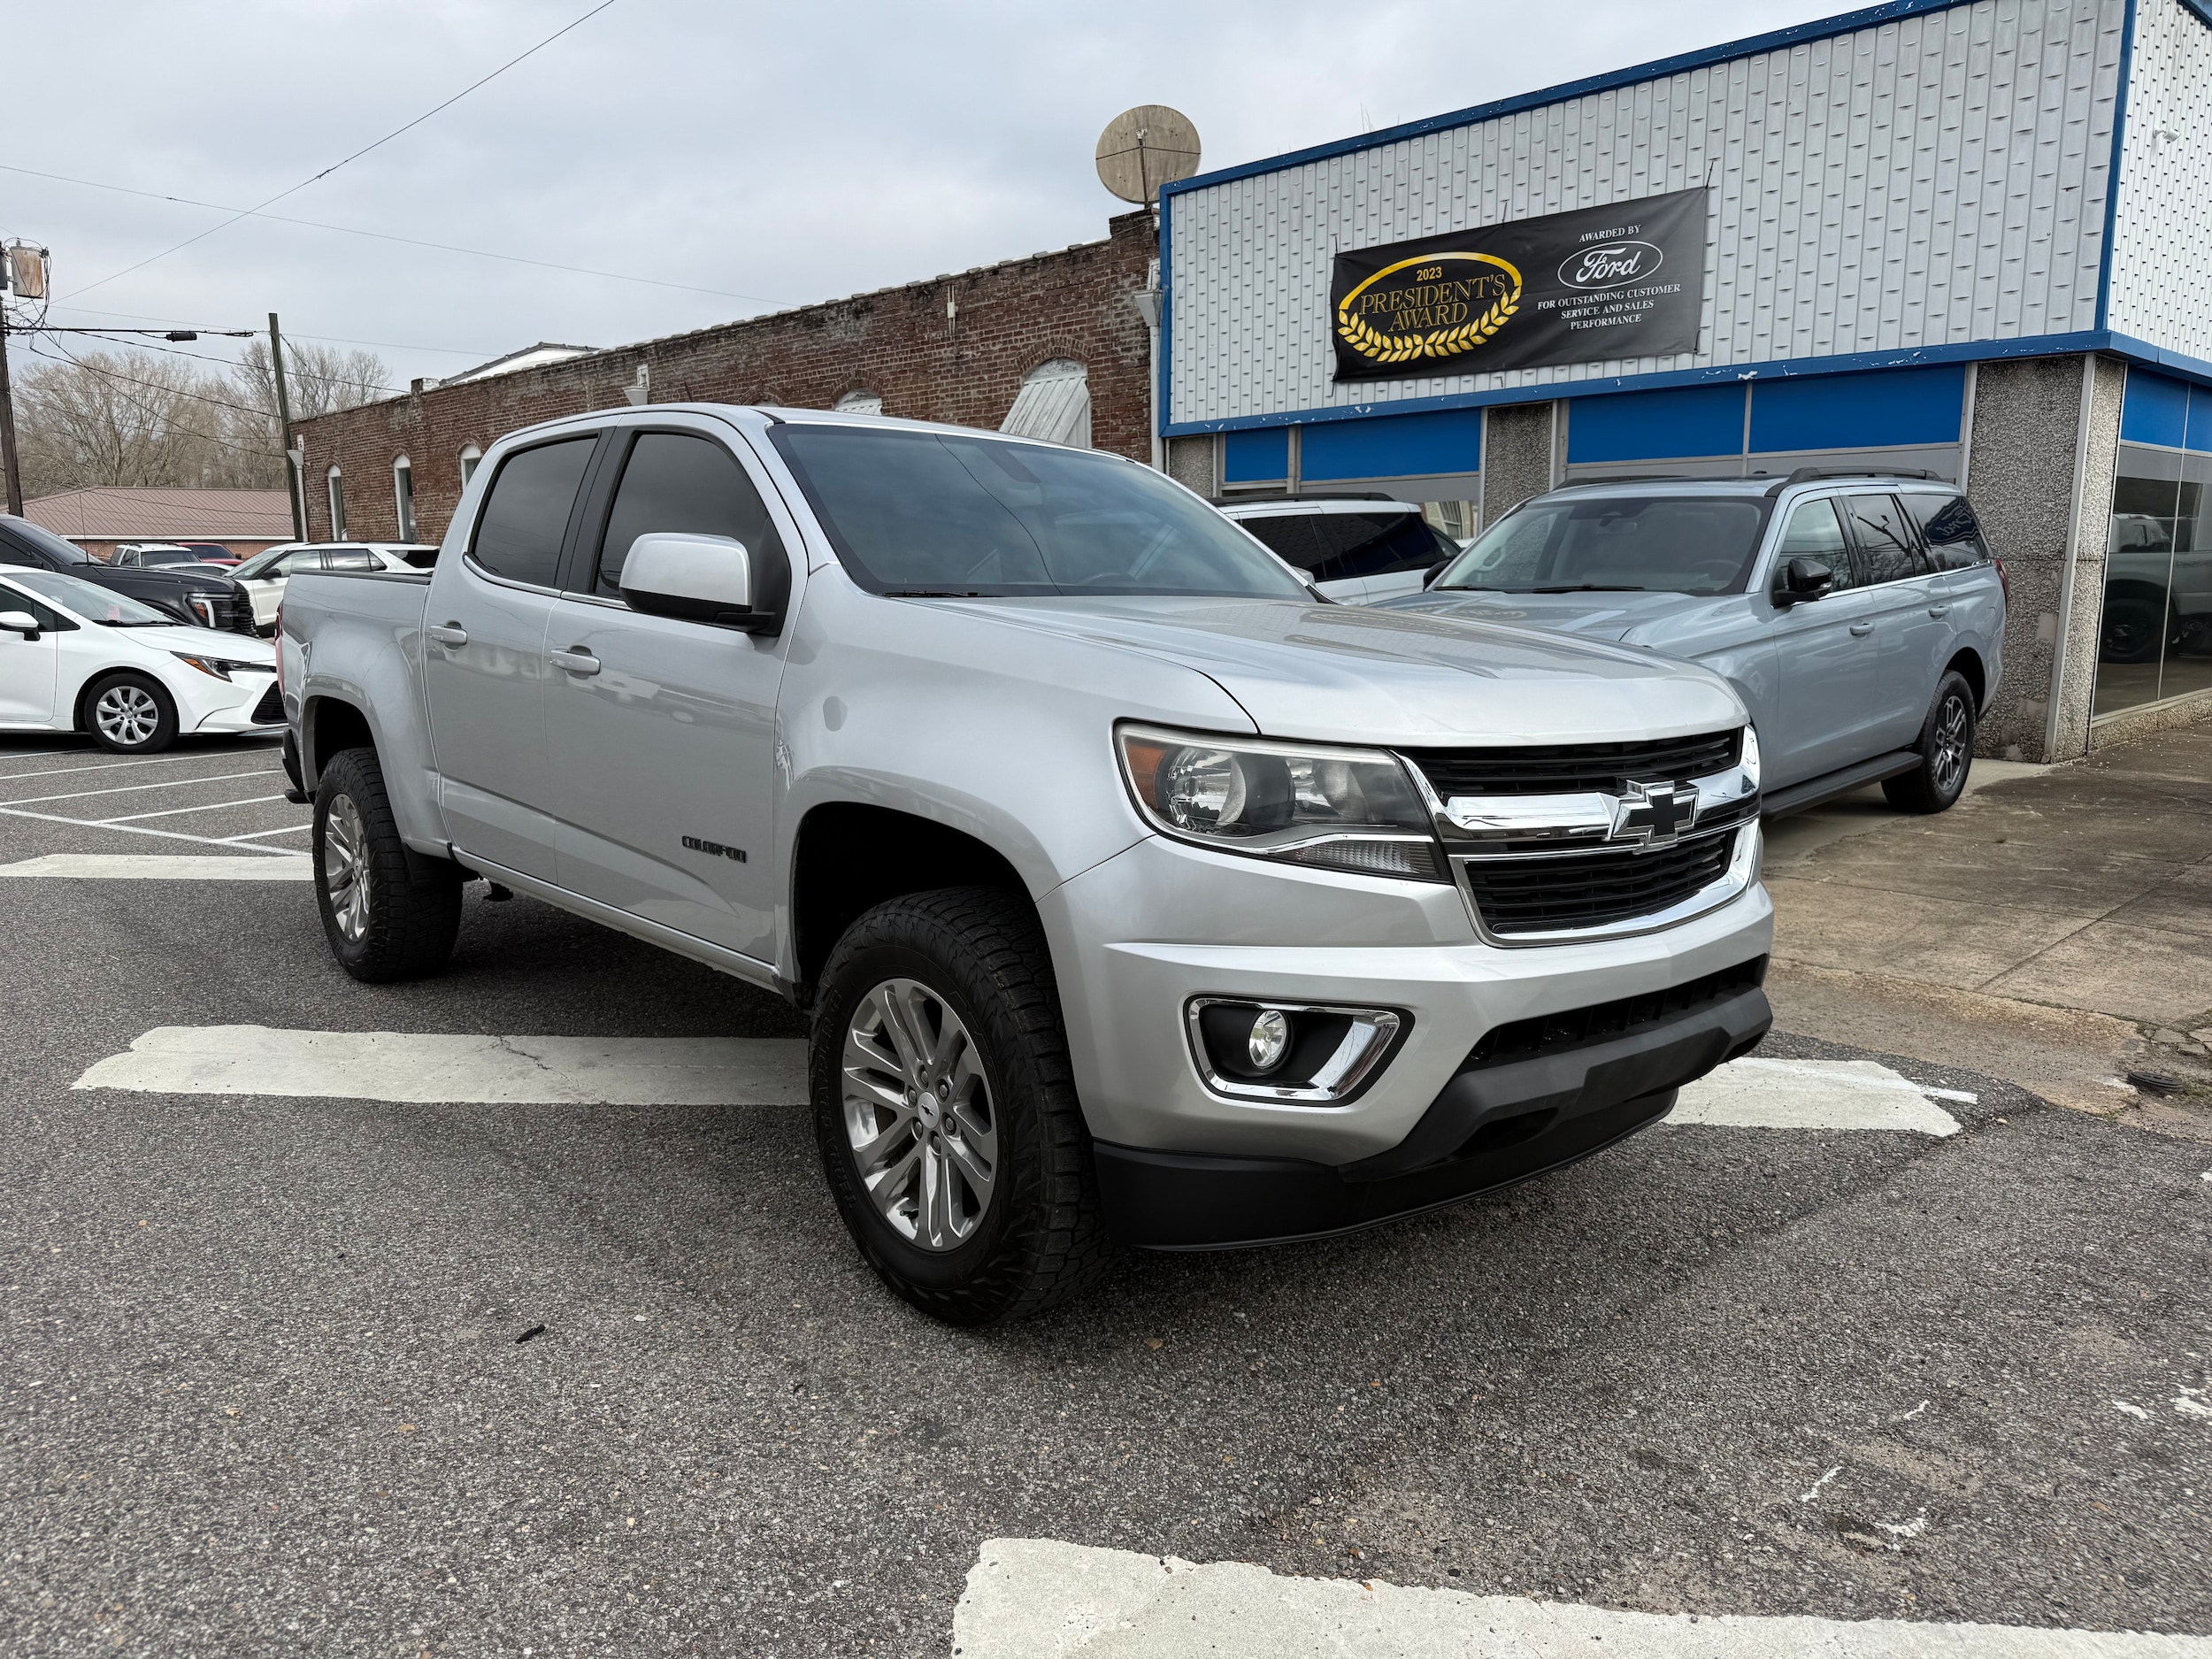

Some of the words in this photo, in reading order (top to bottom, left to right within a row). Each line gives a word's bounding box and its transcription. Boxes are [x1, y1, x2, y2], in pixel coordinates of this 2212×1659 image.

[1578, 227, 1625, 242] AWARDED
[1628, 224, 1642, 235] BY
[1416, 266, 1442, 281] 2023
[1575, 247, 1642, 283] Ford
[1358, 273, 1506, 315] PRESIDENT'S
[1537, 300, 1555, 310] FOR
[1557, 291, 1624, 307] OUTSTANDING
[1626, 283, 1681, 299] CUSTOMER
[1387, 302, 1469, 333] AWARD
[1561, 306, 1601, 319] SERVICE
[1602, 303, 1623, 314] AND
[1624, 299, 1655, 311] SALES
[1570, 313, 1642, 330] PERFORMANCE
[681, 835, 747, 864] COLORADO
[826, 1135, 857, 1210] TERRA
